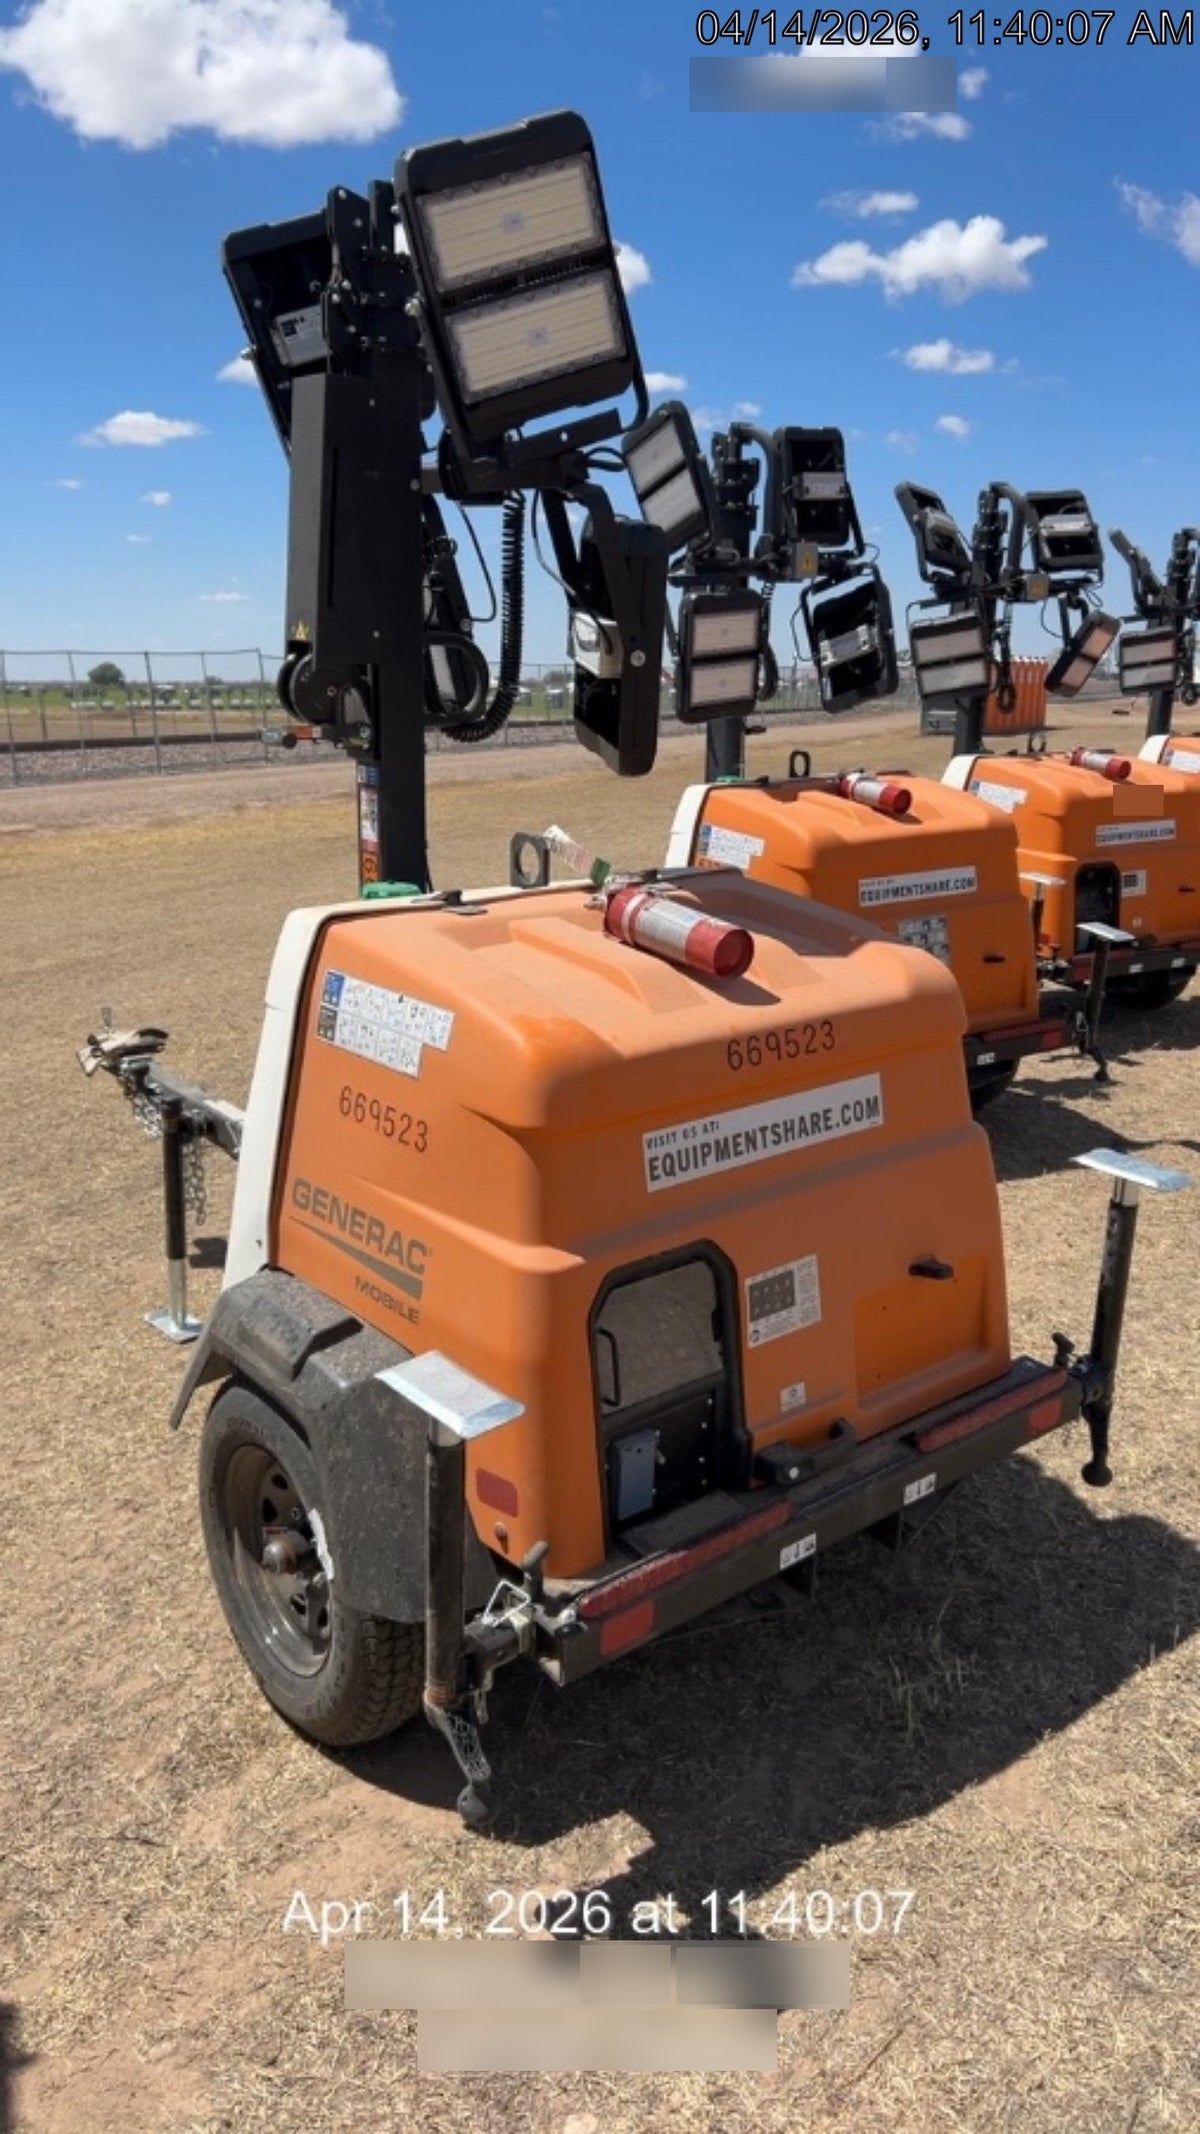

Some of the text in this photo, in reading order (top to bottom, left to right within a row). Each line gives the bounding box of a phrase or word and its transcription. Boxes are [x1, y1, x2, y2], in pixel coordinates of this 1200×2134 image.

[727, 1019, 836, 1071] 669523
[338, 1085, 429, 1154] 669523
[645, 1120, 720, 1150] VISIT US AT:
[648, 1095, 880, 1182] EQUIPMENTSHARE.COM
[292, 1177, 428, 1276] GENERAC
[354, 1275, 421, 1325] MOBILE
